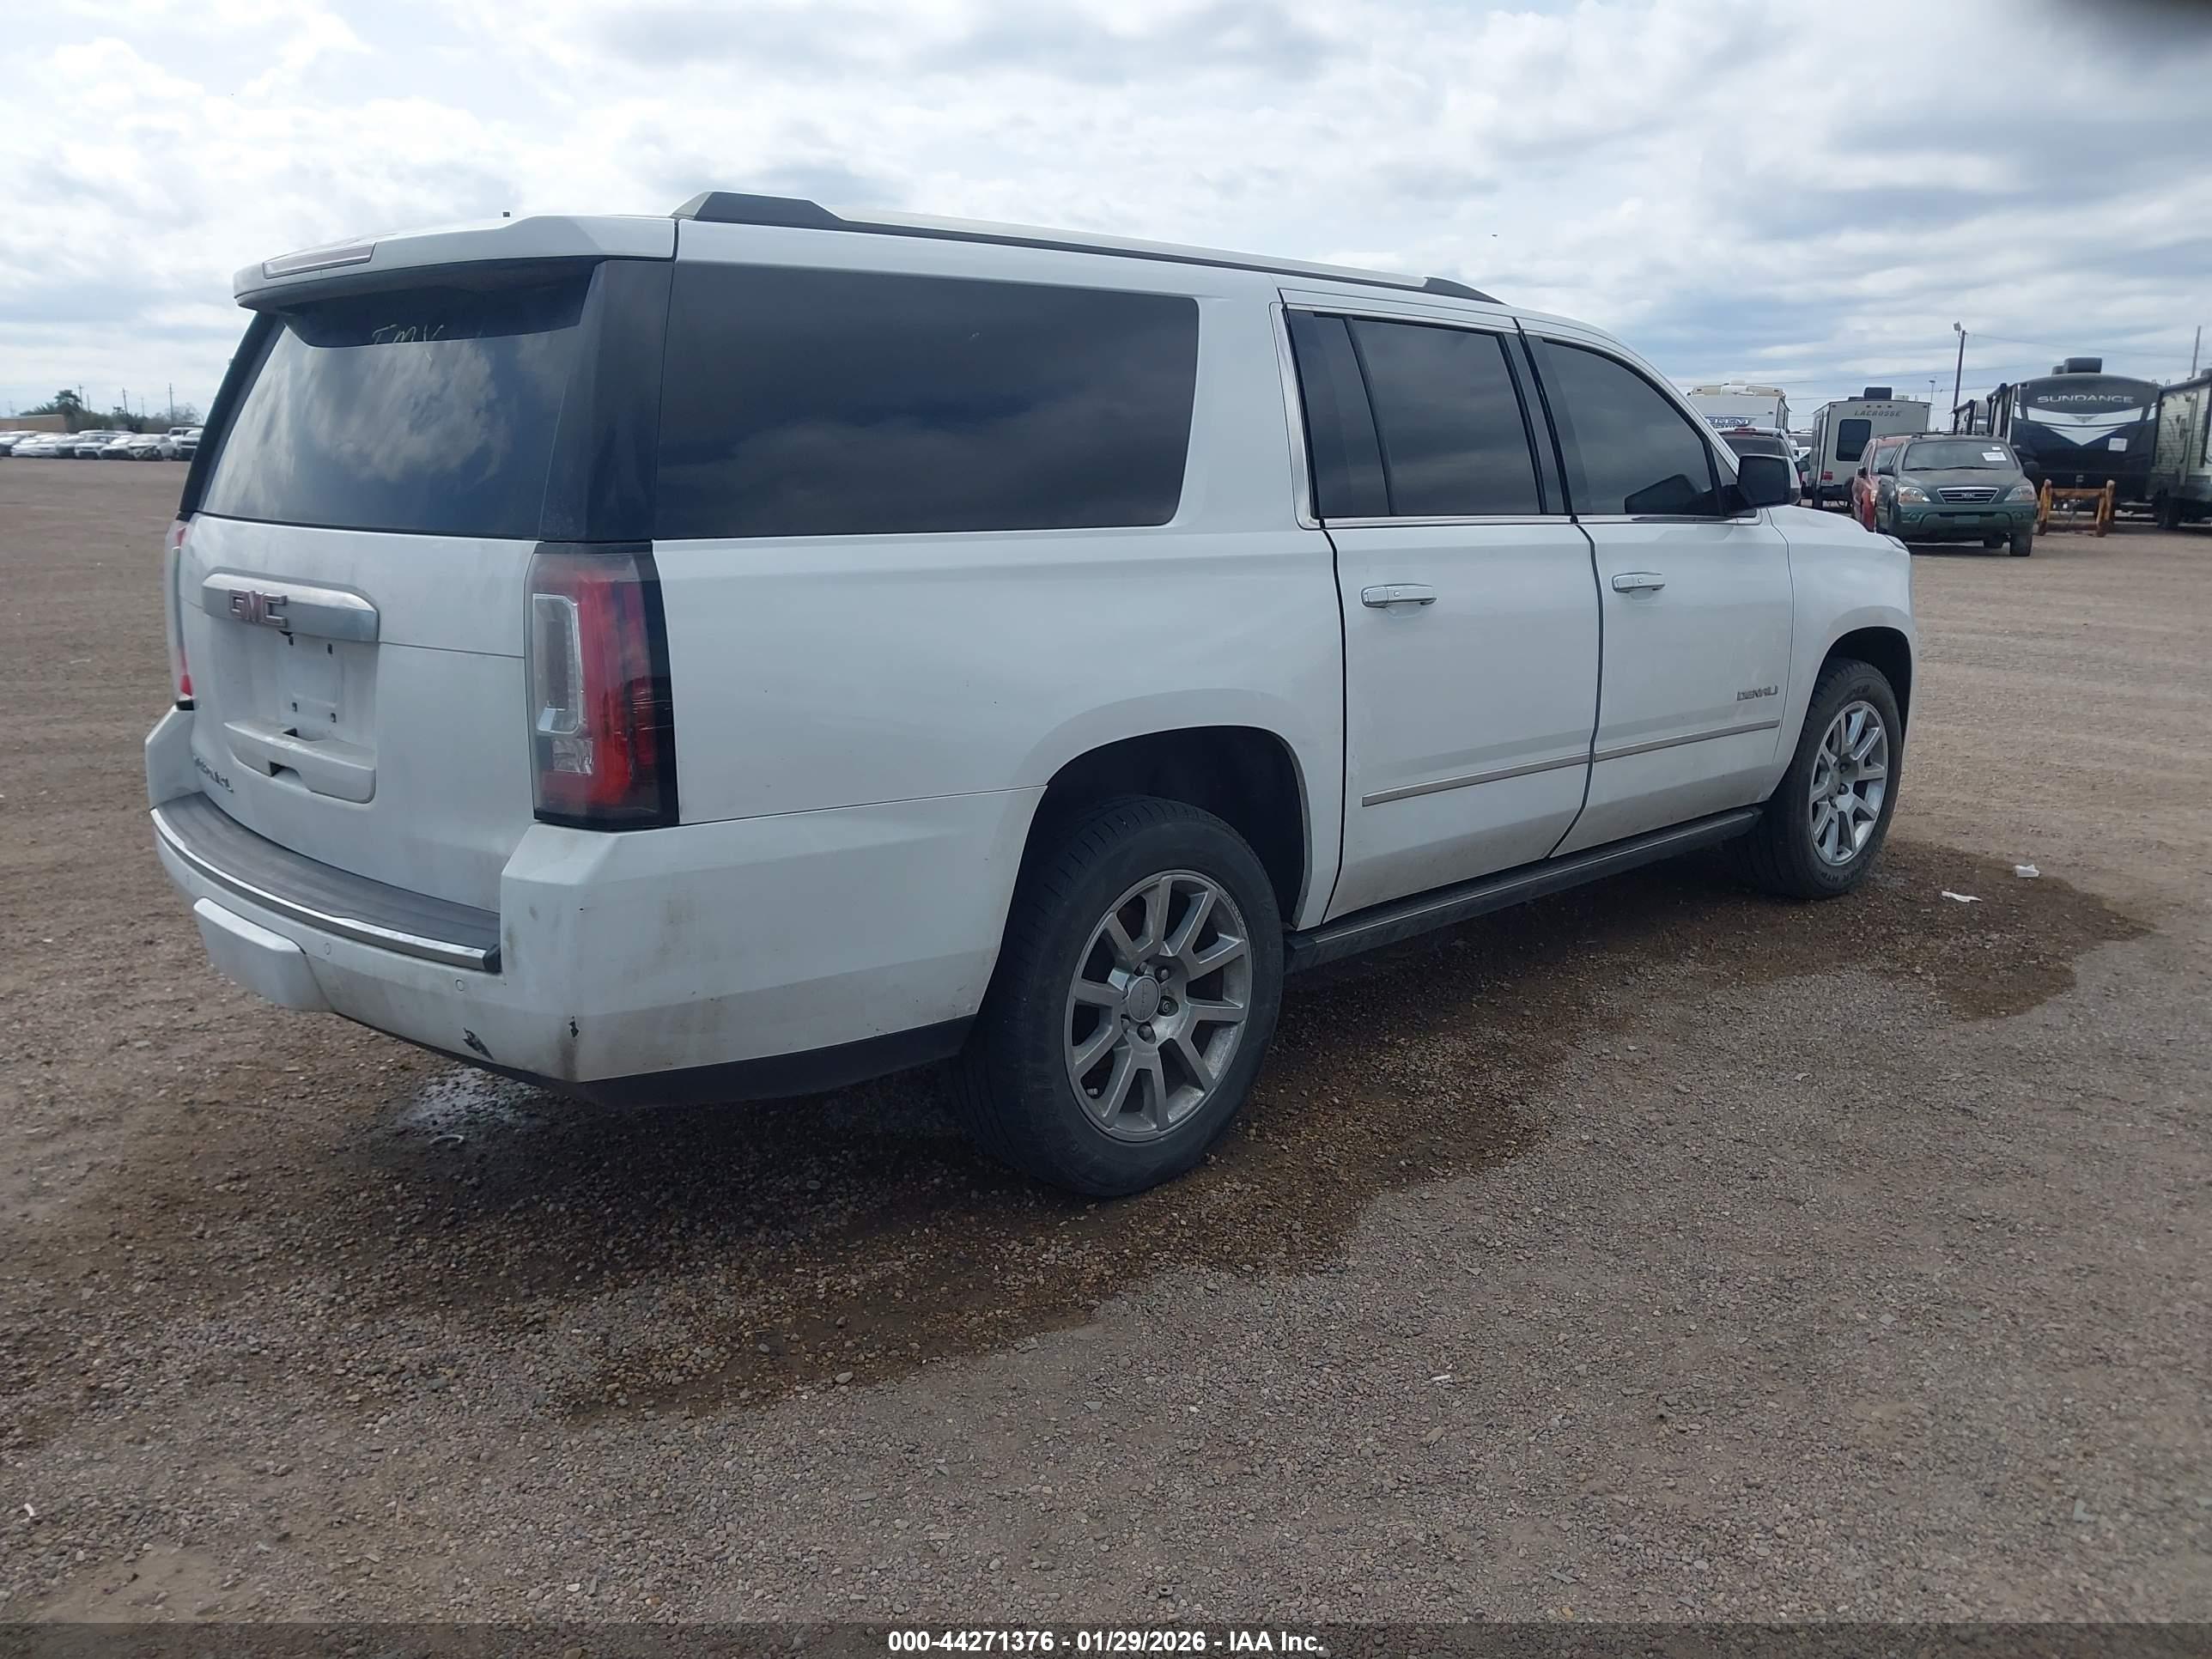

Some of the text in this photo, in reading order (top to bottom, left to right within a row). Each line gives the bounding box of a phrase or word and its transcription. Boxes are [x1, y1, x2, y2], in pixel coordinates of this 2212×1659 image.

[2037, 394, 2135, 404] SUNDANCE
[1854, 410, 1903, 418] LACROSSE
[228, 588, 288, 628] GMC
